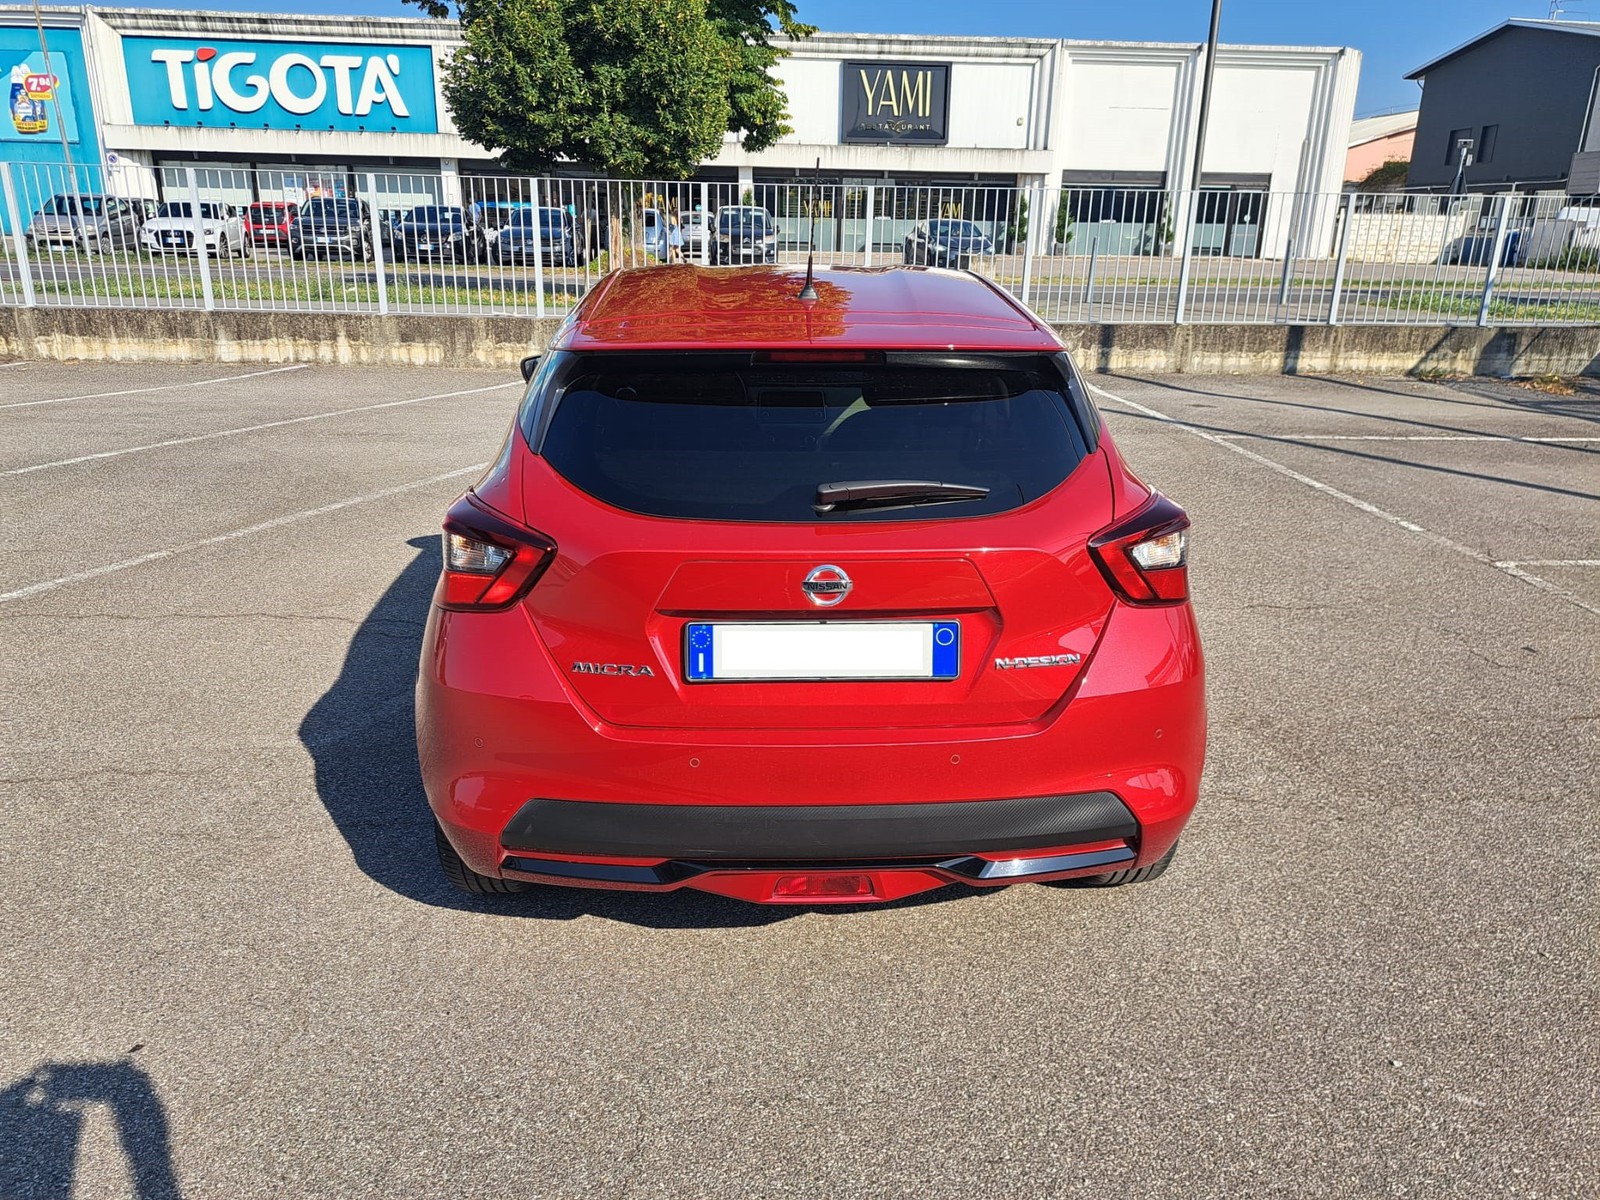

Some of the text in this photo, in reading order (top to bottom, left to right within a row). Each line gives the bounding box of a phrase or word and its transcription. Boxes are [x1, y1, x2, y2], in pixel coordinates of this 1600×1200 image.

[860, 69, 932, 117] YAMI
[807, 581, 848, 590] NISSAN
[572, 662, 655, 677] MICRA
[994, 653, 1080, 670] N-DESIGN
